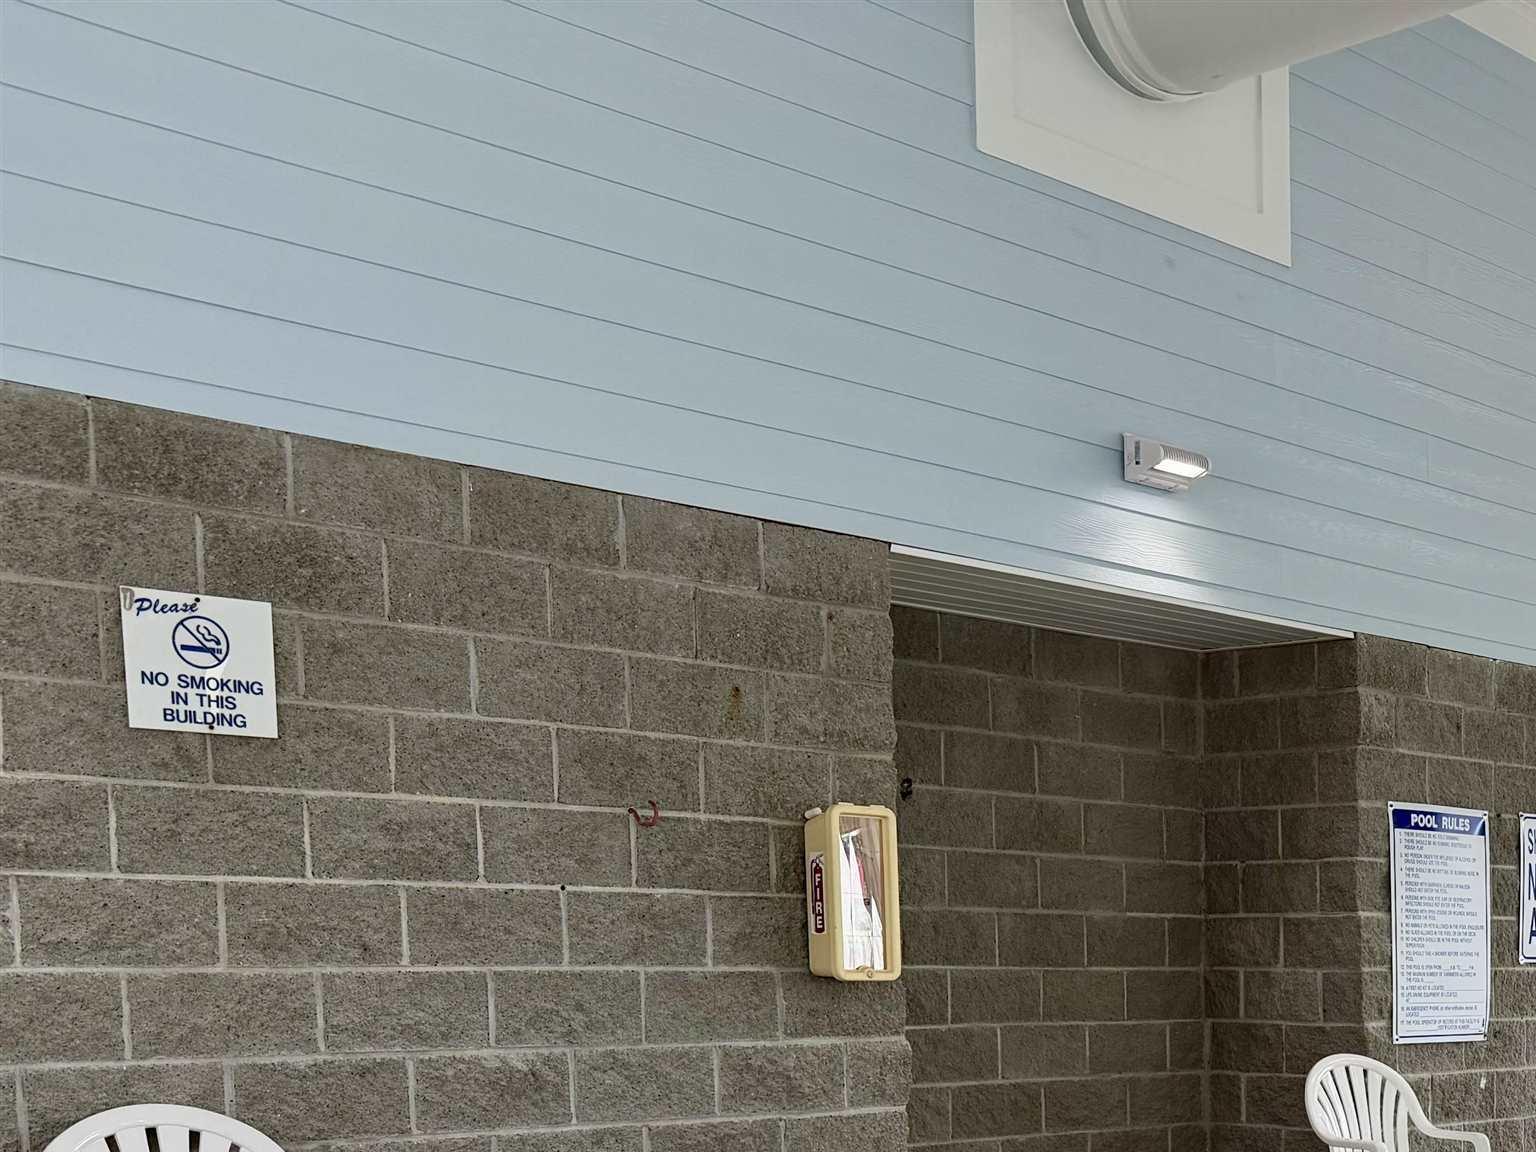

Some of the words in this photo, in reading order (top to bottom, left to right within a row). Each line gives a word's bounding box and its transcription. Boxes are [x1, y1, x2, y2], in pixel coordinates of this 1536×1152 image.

[133, 597, 199, 616] Please
[140, 670, 169, 687] NO
[177, 673, 264, 696] SMOKING
[171, 691, 188, 706] IN
[195, 693, 237, 710] THIS
[163, 708, 247, 729] BUILDING
[1410, 813, 1438, 828] POOL
[1442, 816, 1470, 831] RULES
[815, 873, 823, 928] FIRE
